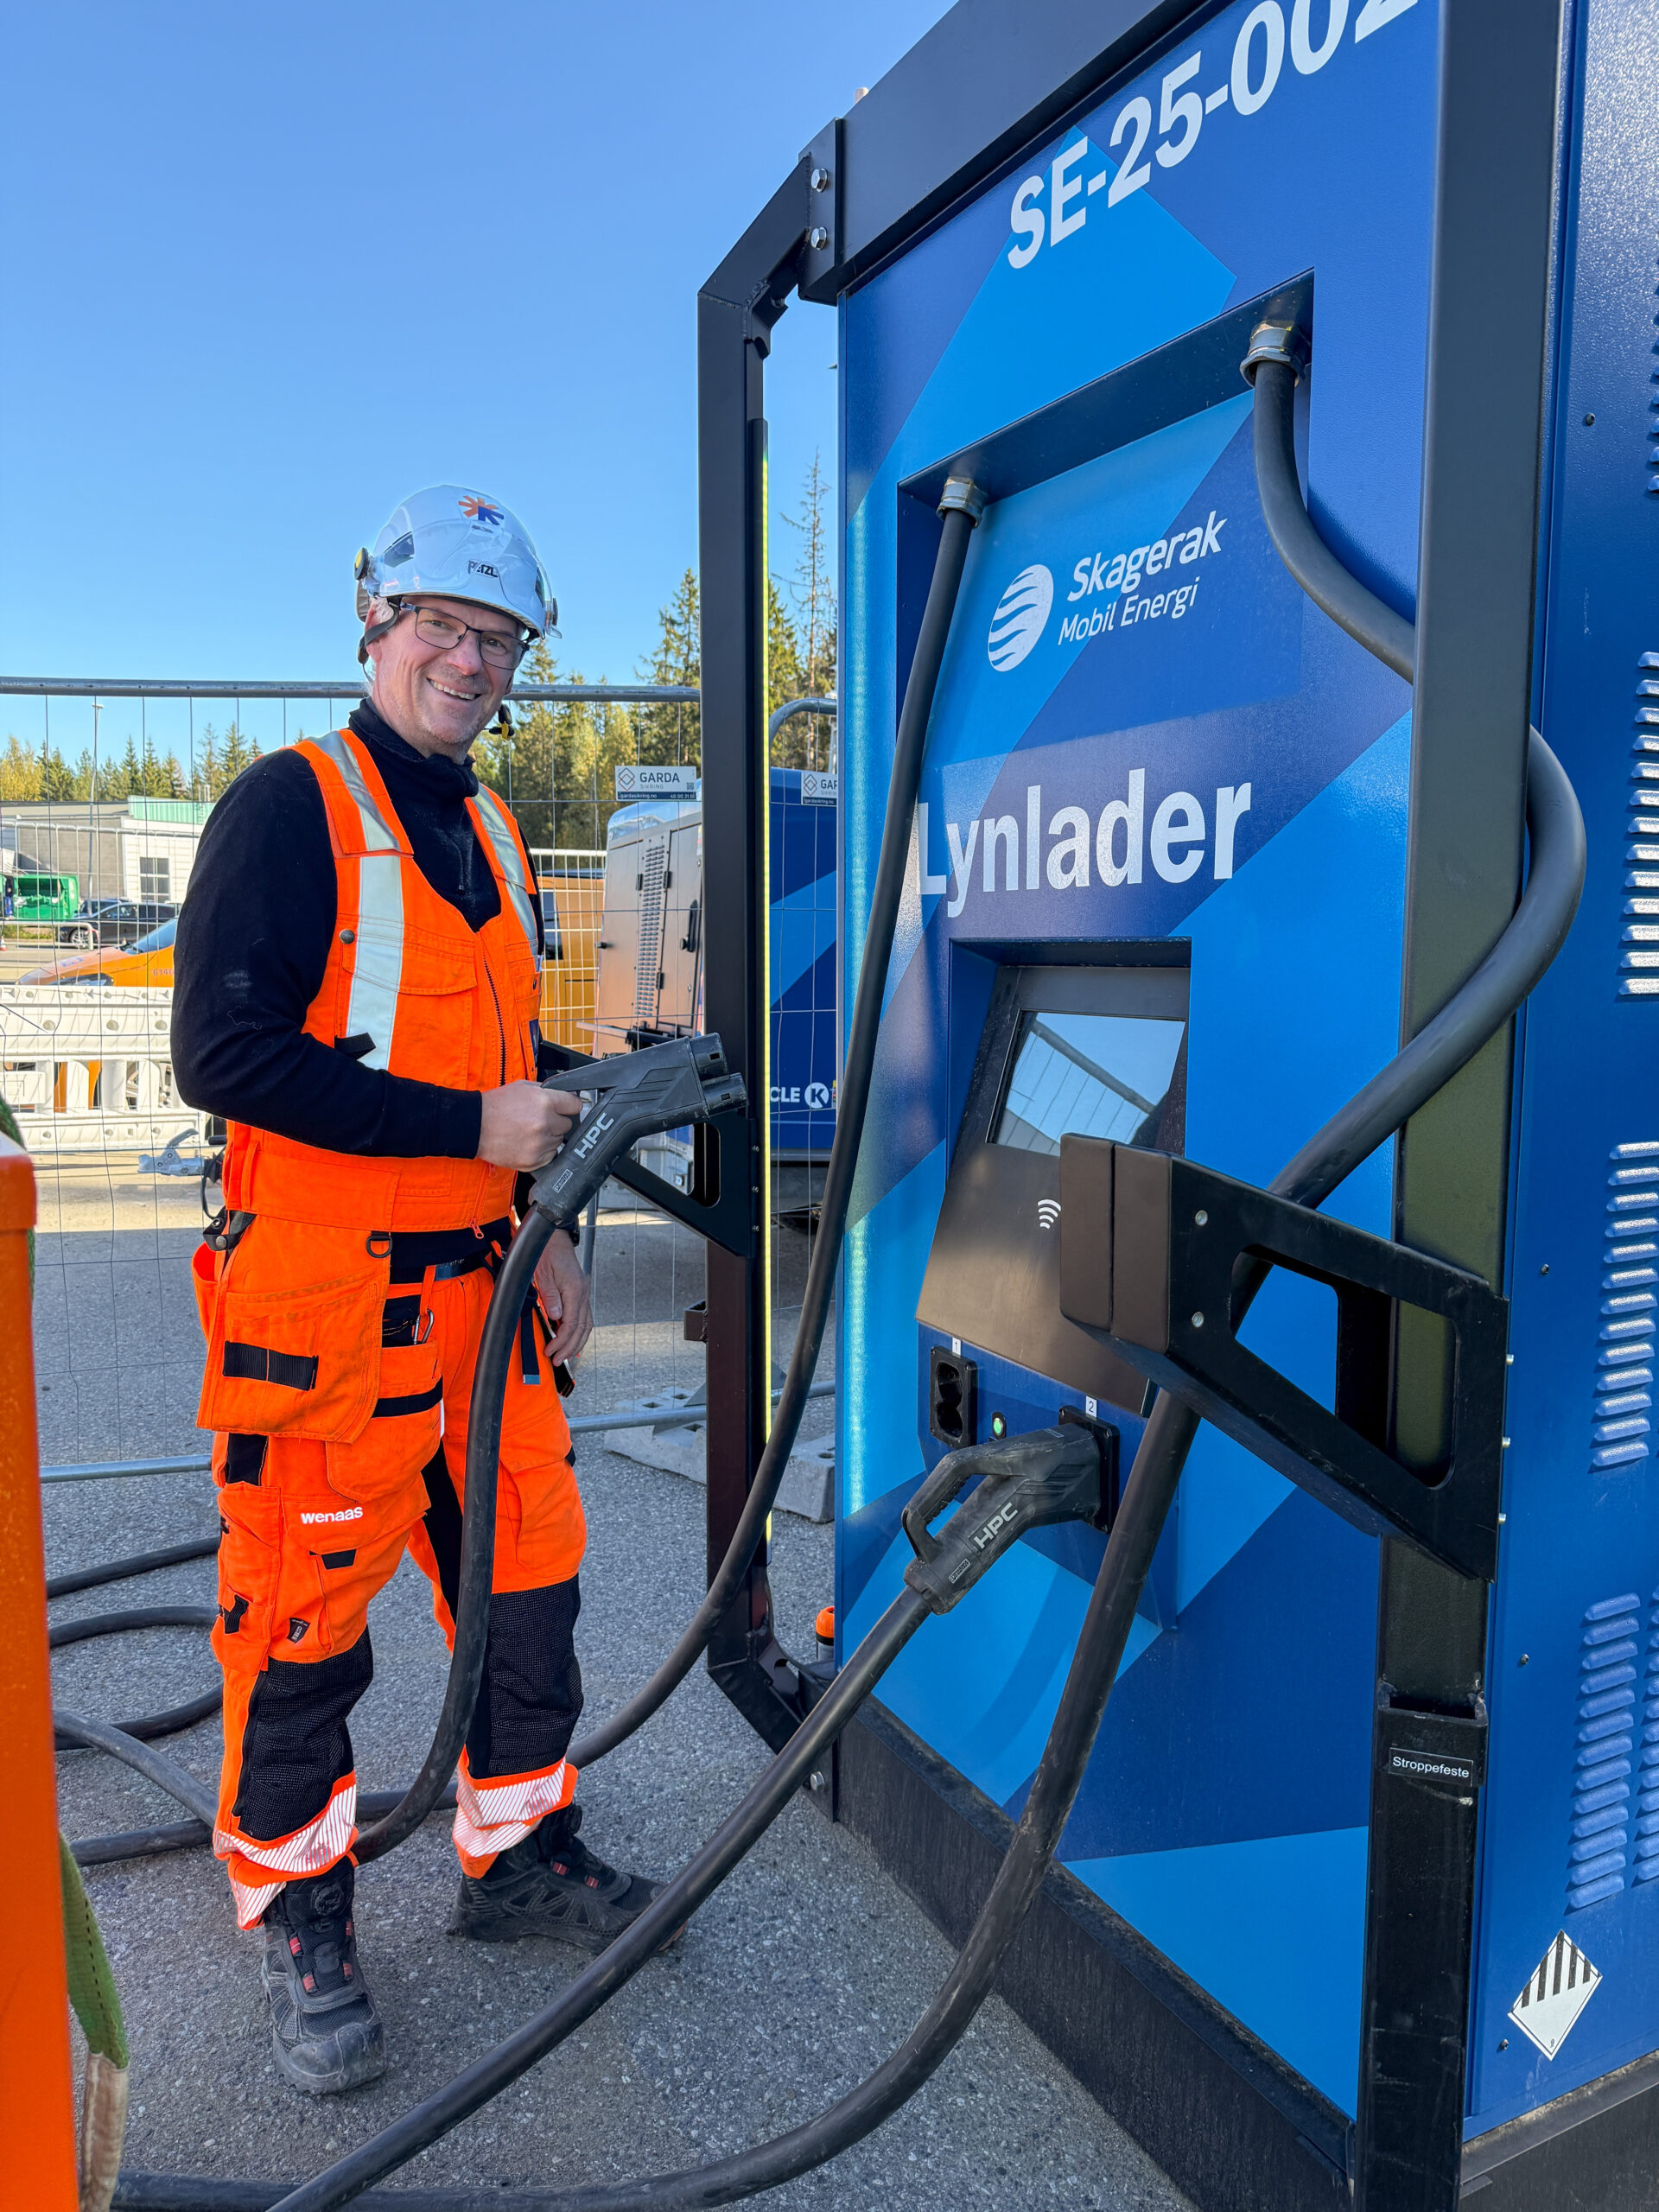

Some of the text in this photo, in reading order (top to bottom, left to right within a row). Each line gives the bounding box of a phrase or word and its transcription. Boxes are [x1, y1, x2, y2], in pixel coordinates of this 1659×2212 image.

[1067, 510, 1228, 602] Skagerak
[1058, 575, 1200, 646] Mobil Energi
[639, 772, 680, 783] GARDA
[917, 767, 1252, 918] Lynlader
[574, 1112, 614, 1159] HPC
[1089, 1401, 1094, 1413] 2
[301, 1507, 364, 1524] wenaas
[973, 1502, 1018, 1549] HPC
[1393, 1756, 1470, 1778] Stroppefeste
